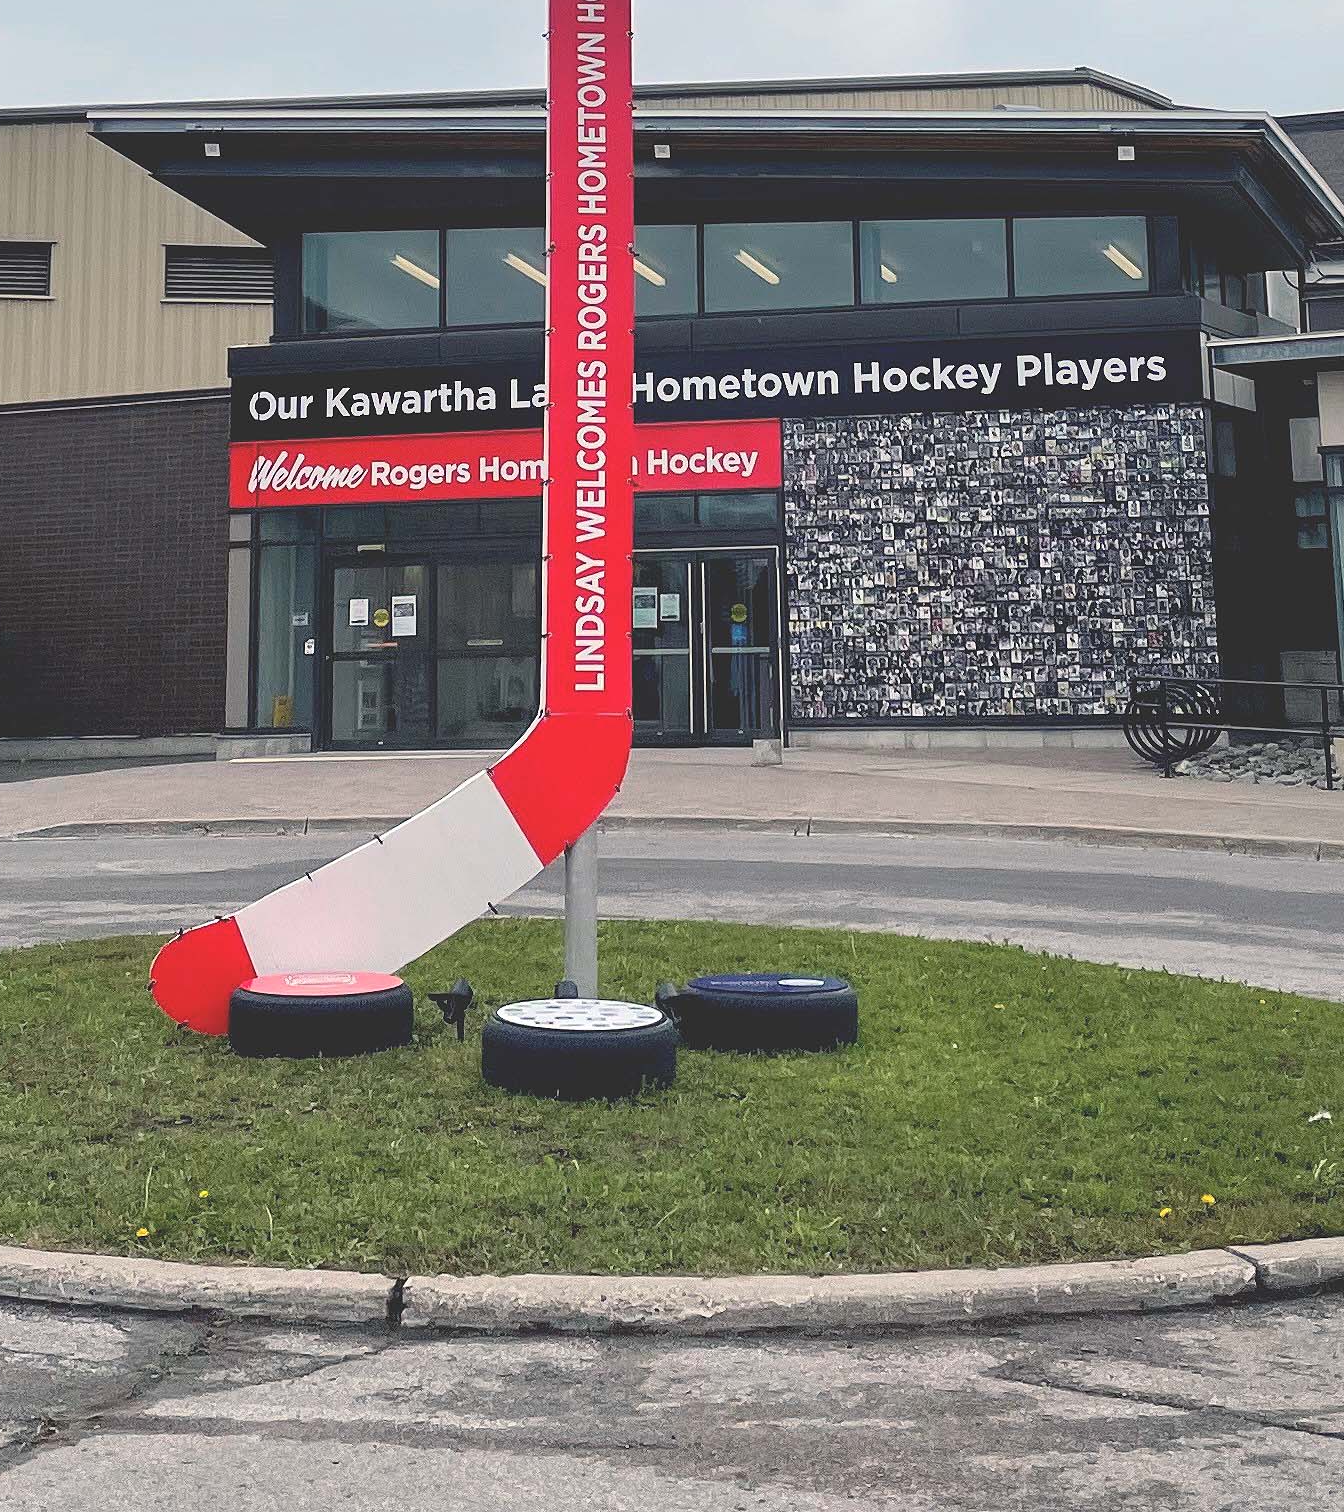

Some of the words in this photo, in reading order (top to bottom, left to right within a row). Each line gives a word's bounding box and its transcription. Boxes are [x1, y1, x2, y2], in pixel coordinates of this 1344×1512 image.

[576, 35, 608, 215] HOMETOWN
[577, 224, 608, 351] ROGERS
[249, 391, 314, 422] Our
[325, 379, 497, 418] Kawartha
[632, 366, 840, 404] Hometown
[853, 357, 1002, 395] Hockey
[1015, 351, 1168, 391] Players
[575, 360, 608, 544] WELCOMES
[247, 450, 369, 494] Welcome
[371, 460, 472, 491] Rogers
[647, 446, 759, 477] Hockey
[574, 552, 606, 693] LINDSAY
